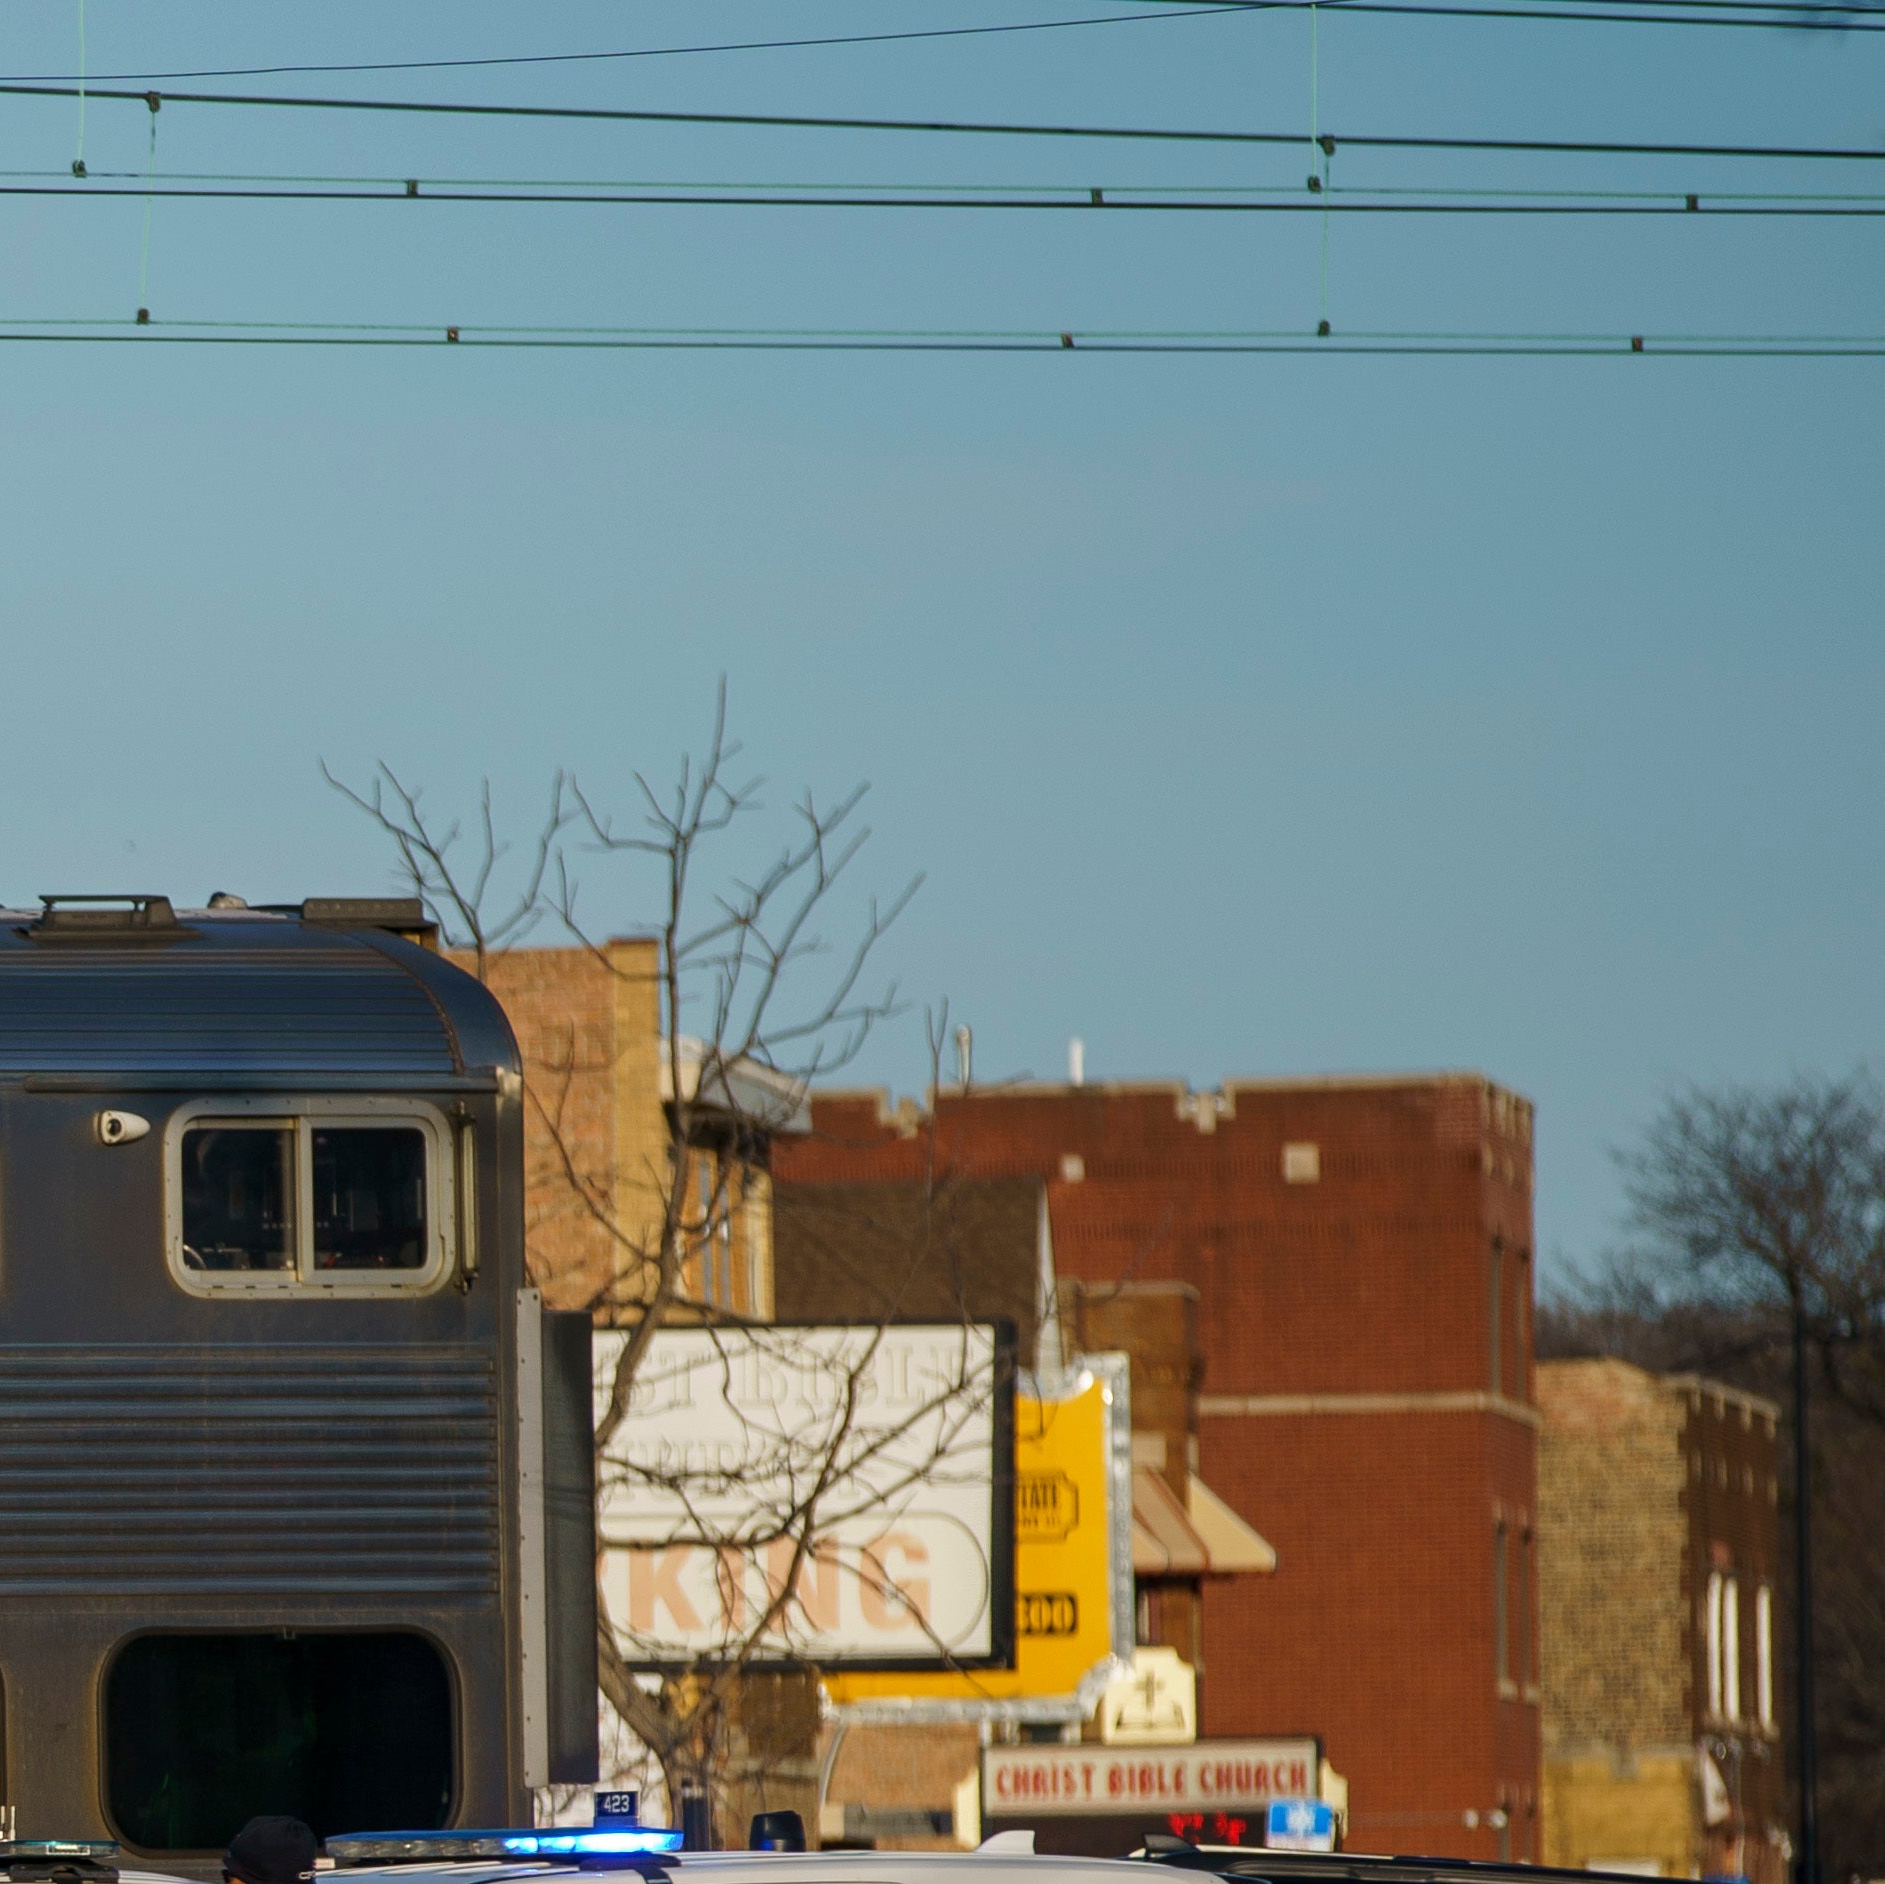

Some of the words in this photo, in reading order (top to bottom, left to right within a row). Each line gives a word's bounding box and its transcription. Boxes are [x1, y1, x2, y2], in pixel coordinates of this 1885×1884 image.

[597, 1533, 933, 1634] KING
[996, 1758, 1095, 1799] CHRIST
[1108, 1760, 1188, 1797] BIBLE
[1199, 1757, 1308, 1795] CHURCH
[604, 1794, 631, 1813] 423
